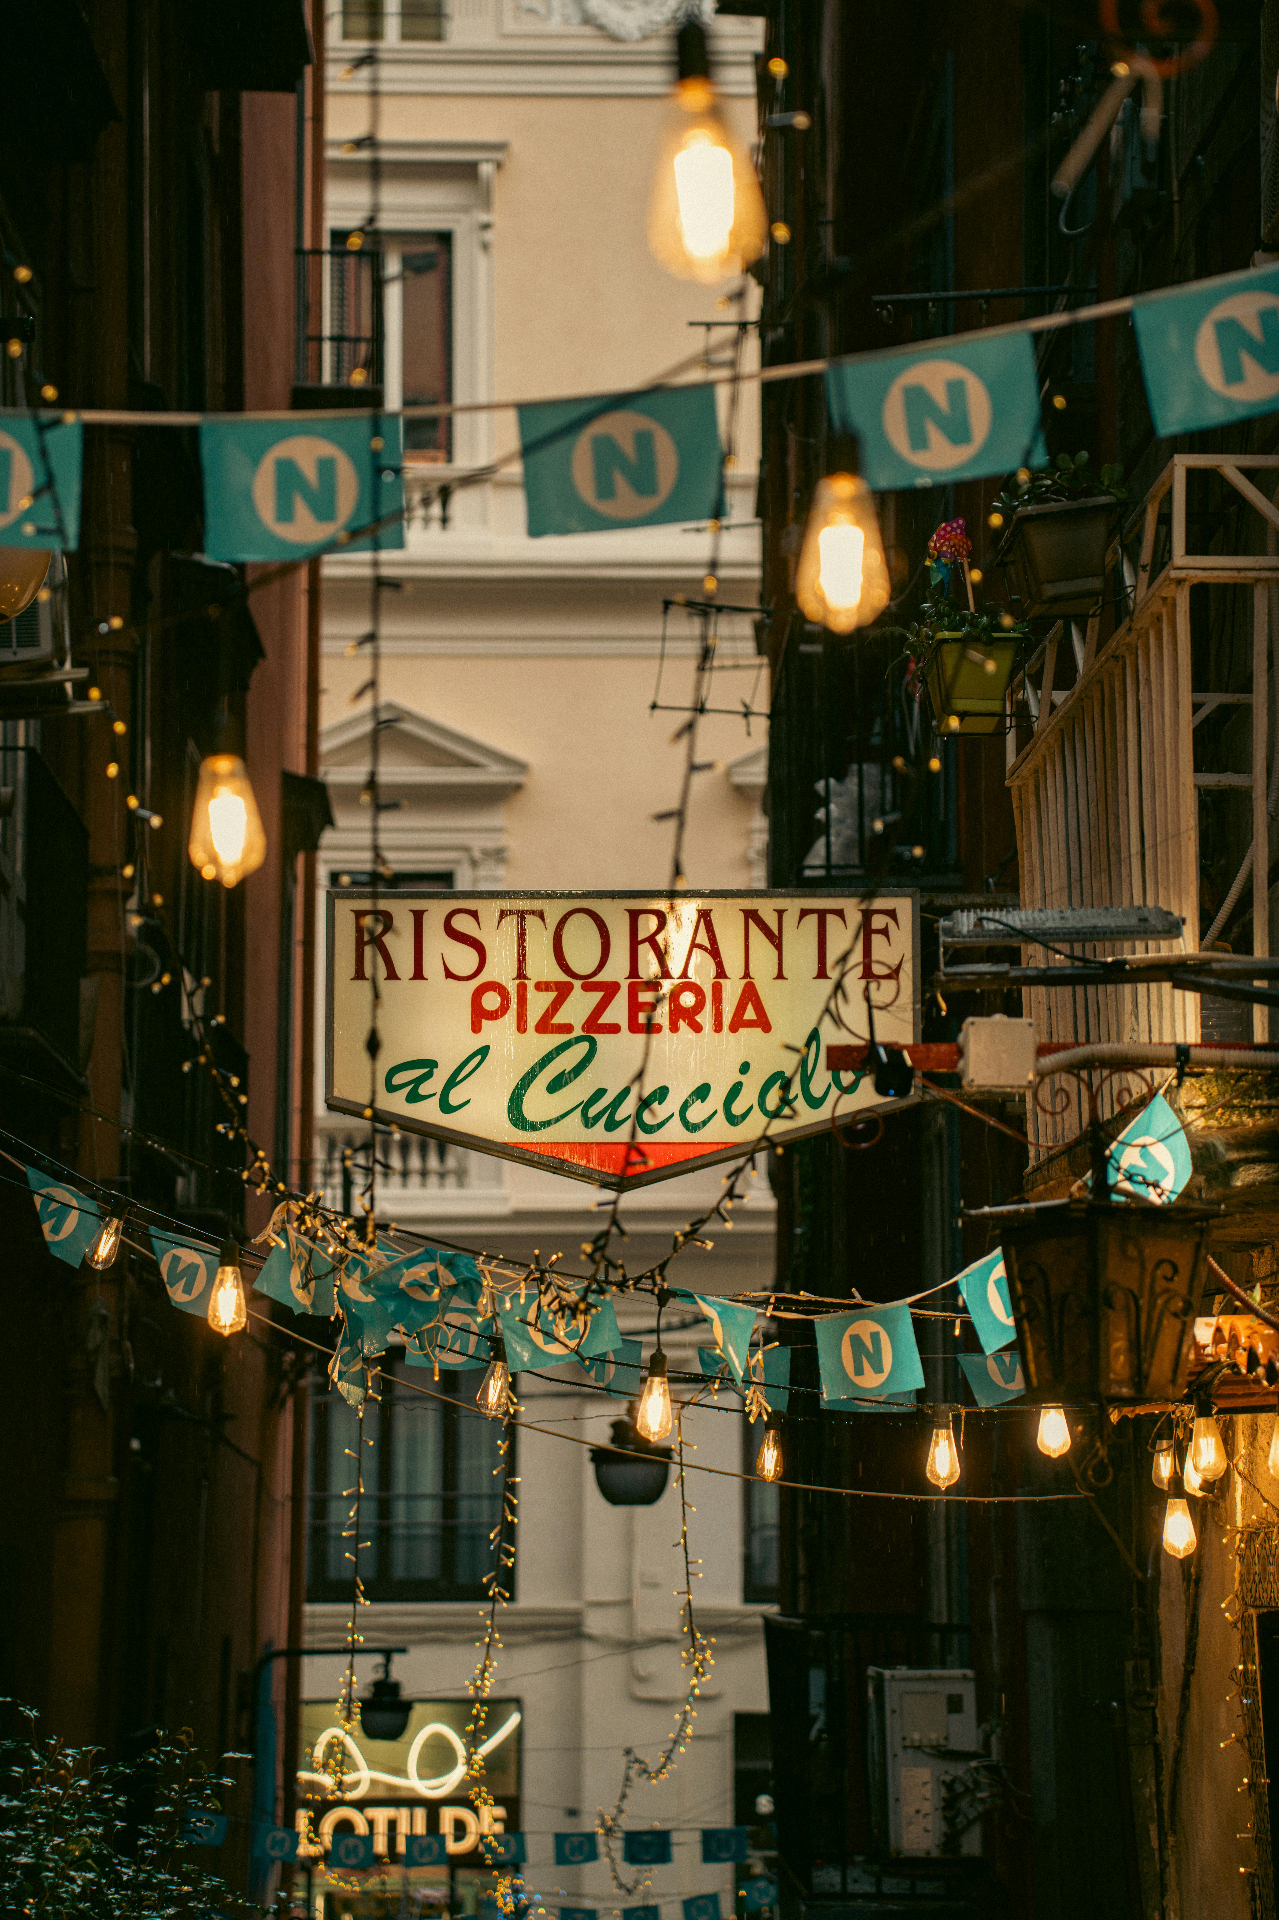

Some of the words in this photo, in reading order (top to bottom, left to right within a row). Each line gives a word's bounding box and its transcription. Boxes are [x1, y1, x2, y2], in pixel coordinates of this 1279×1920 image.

[1213, 305, 1279, 385] N
[901, 377, 974, 452] N
[274, 455, 337, 523] N
[591, 429, 658, 502] N
[350, 907, 905, 982] RISTORANTE
[470, 980, 773, 1035] PIZZERIA
[384, 1045, 491, 1115] al
[849, 1331, 885, 1377] N
